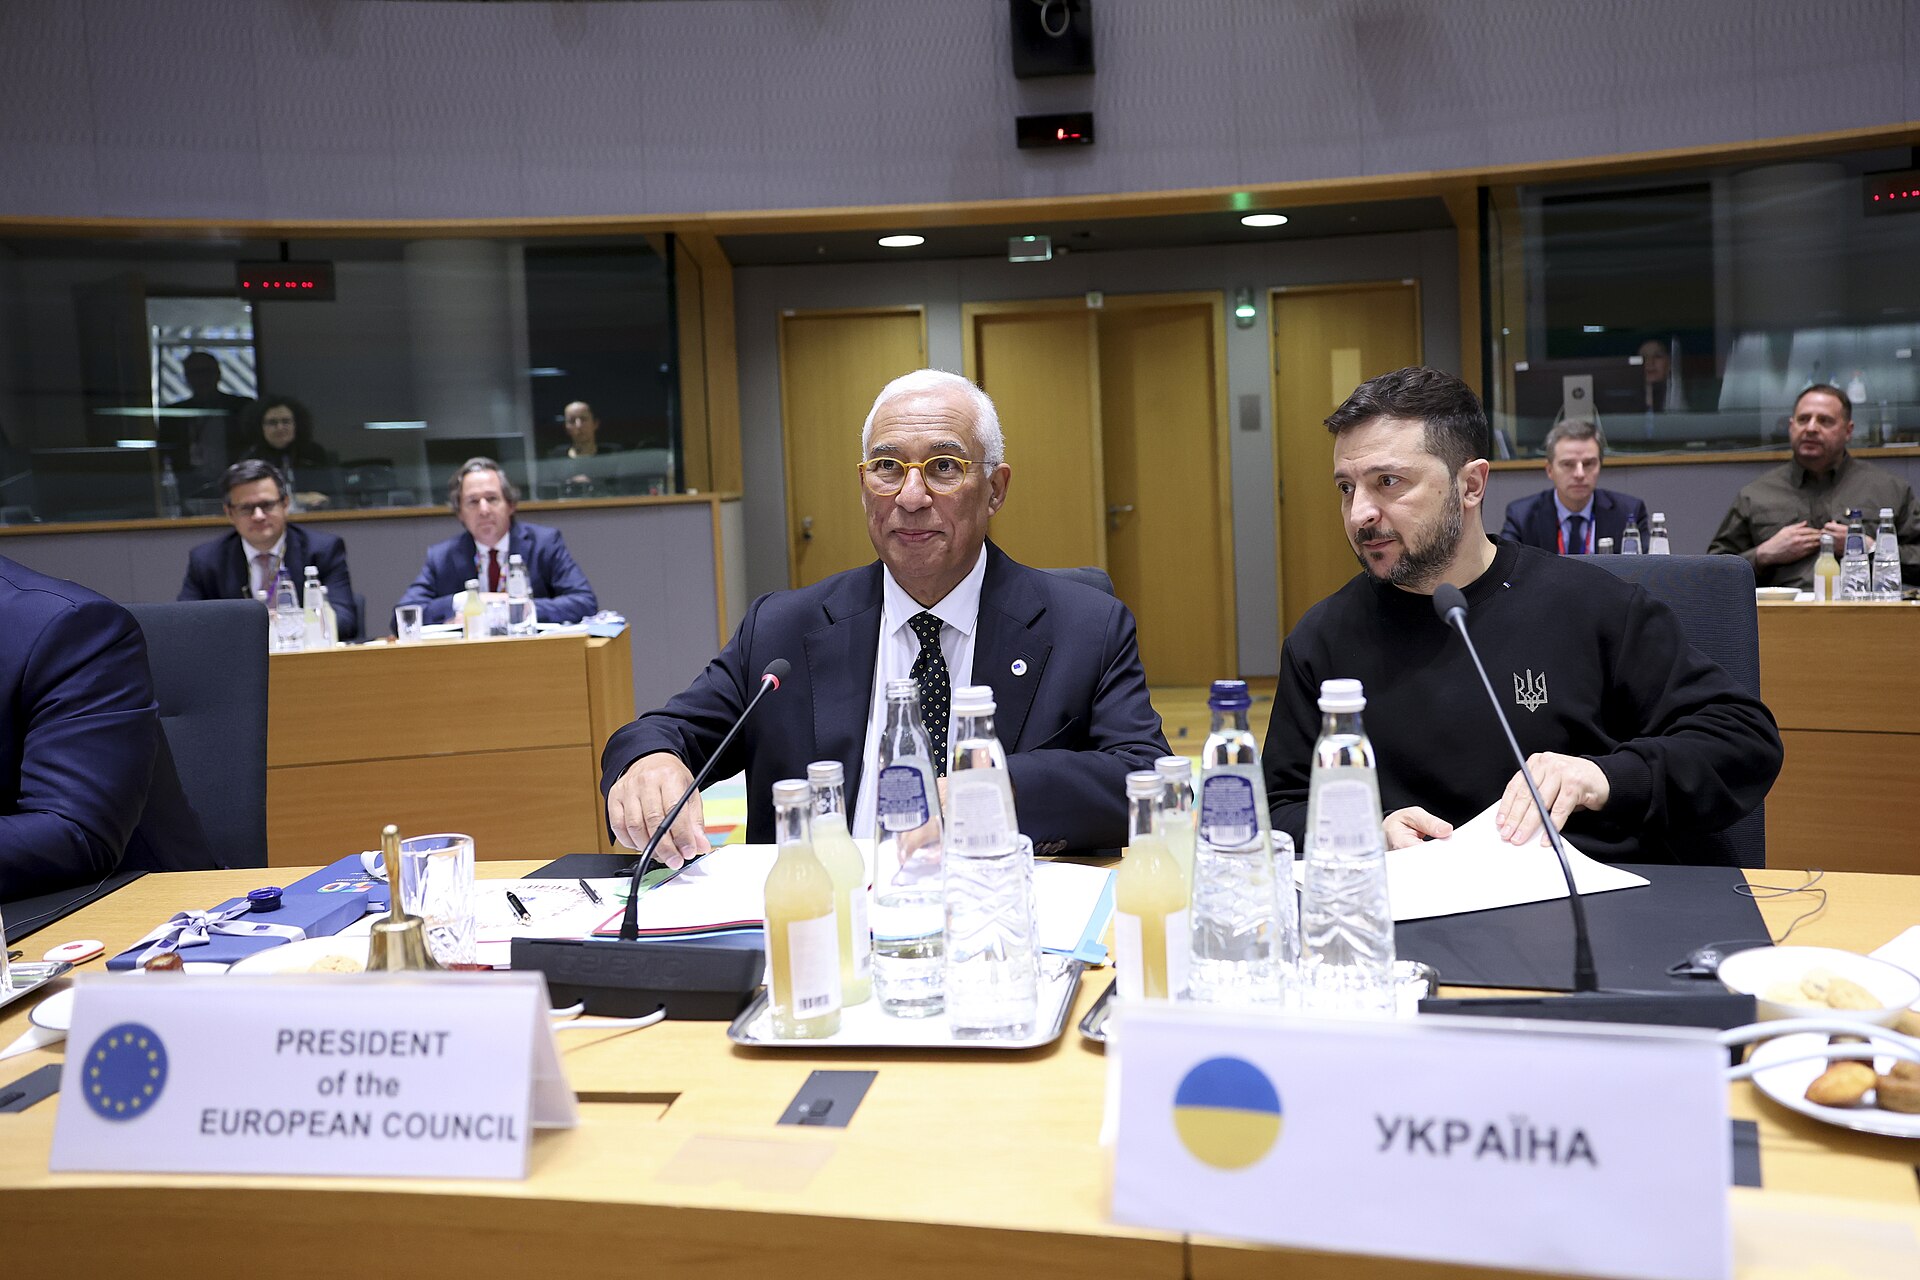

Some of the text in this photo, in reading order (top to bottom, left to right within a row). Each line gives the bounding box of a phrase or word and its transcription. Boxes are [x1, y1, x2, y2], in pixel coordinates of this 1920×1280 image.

[277, 1029, 451, 1058] PRESIDENT
[318, 1072, 401, 1098] of the
[201, 1109, 516, 1142] EUROPEAN COUNCIL
[1376, 1114, 1600, 1169] УКРАЇНА
